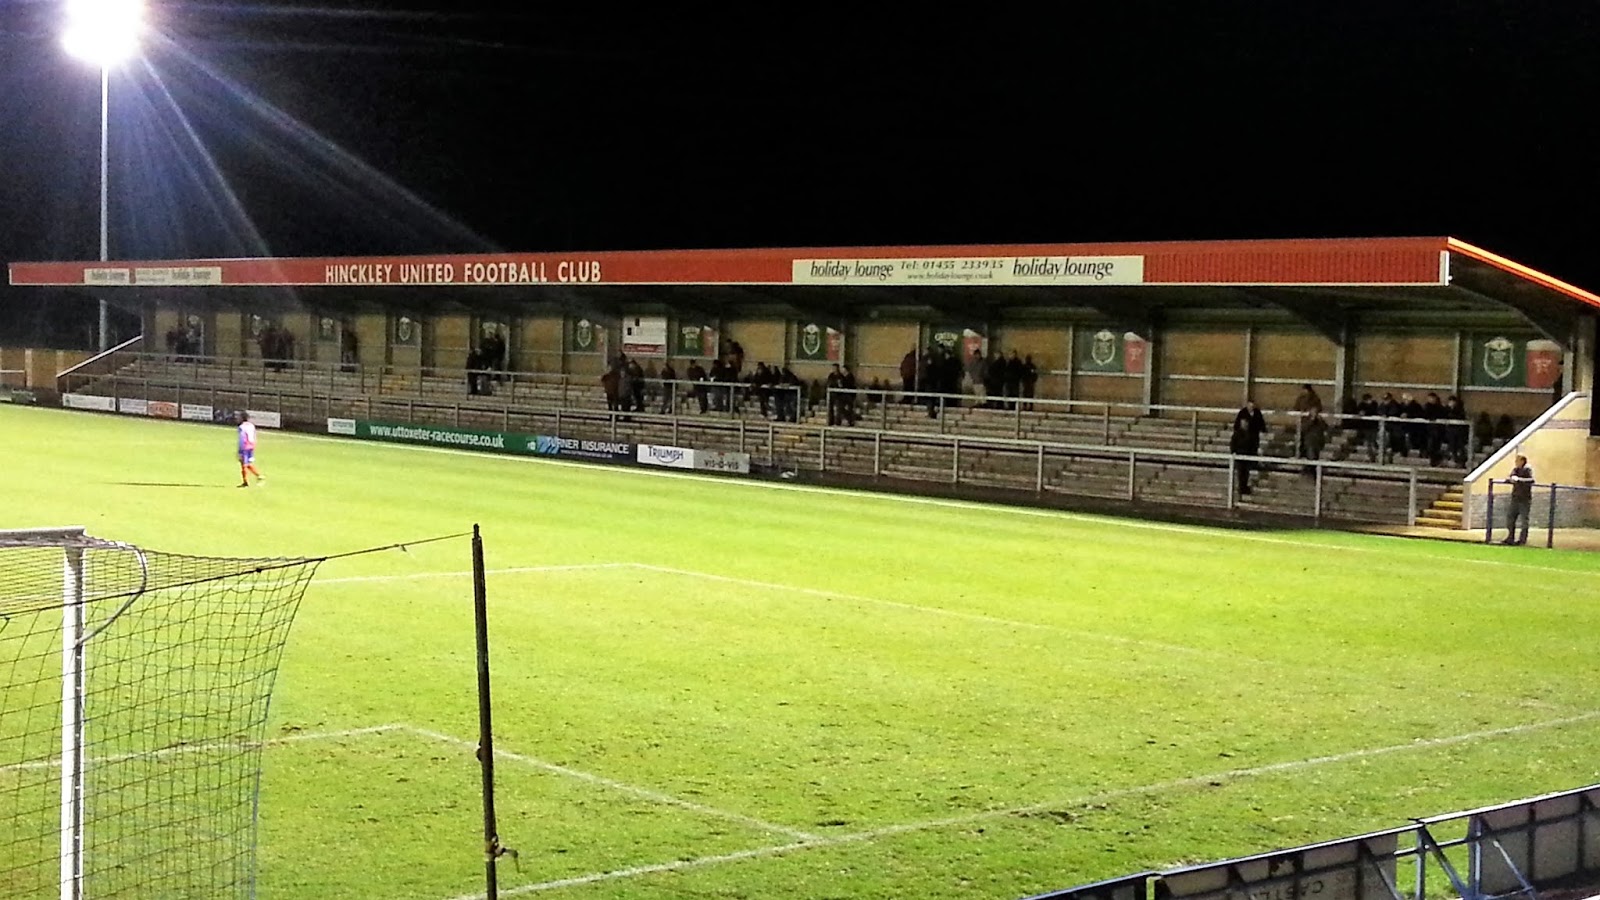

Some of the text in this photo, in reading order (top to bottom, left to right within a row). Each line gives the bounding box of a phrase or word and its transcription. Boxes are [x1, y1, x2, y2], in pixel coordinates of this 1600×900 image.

[325, 261, 601, 283] HINCKLEY UNITED FOOTBALL CLUB
[810, 260, 894, 281] holiday lounge
[900, 260, 1004, 270] Tel: 01455 233935
[1013, 257, 1114, 280] holiday lounge
[369, 424, 504, 449] www.uttoxeter-racecourse.co.uk
[581, 440, 630, 455] INSURANCE
[648, 445, 684, 461] TRIUMPH
